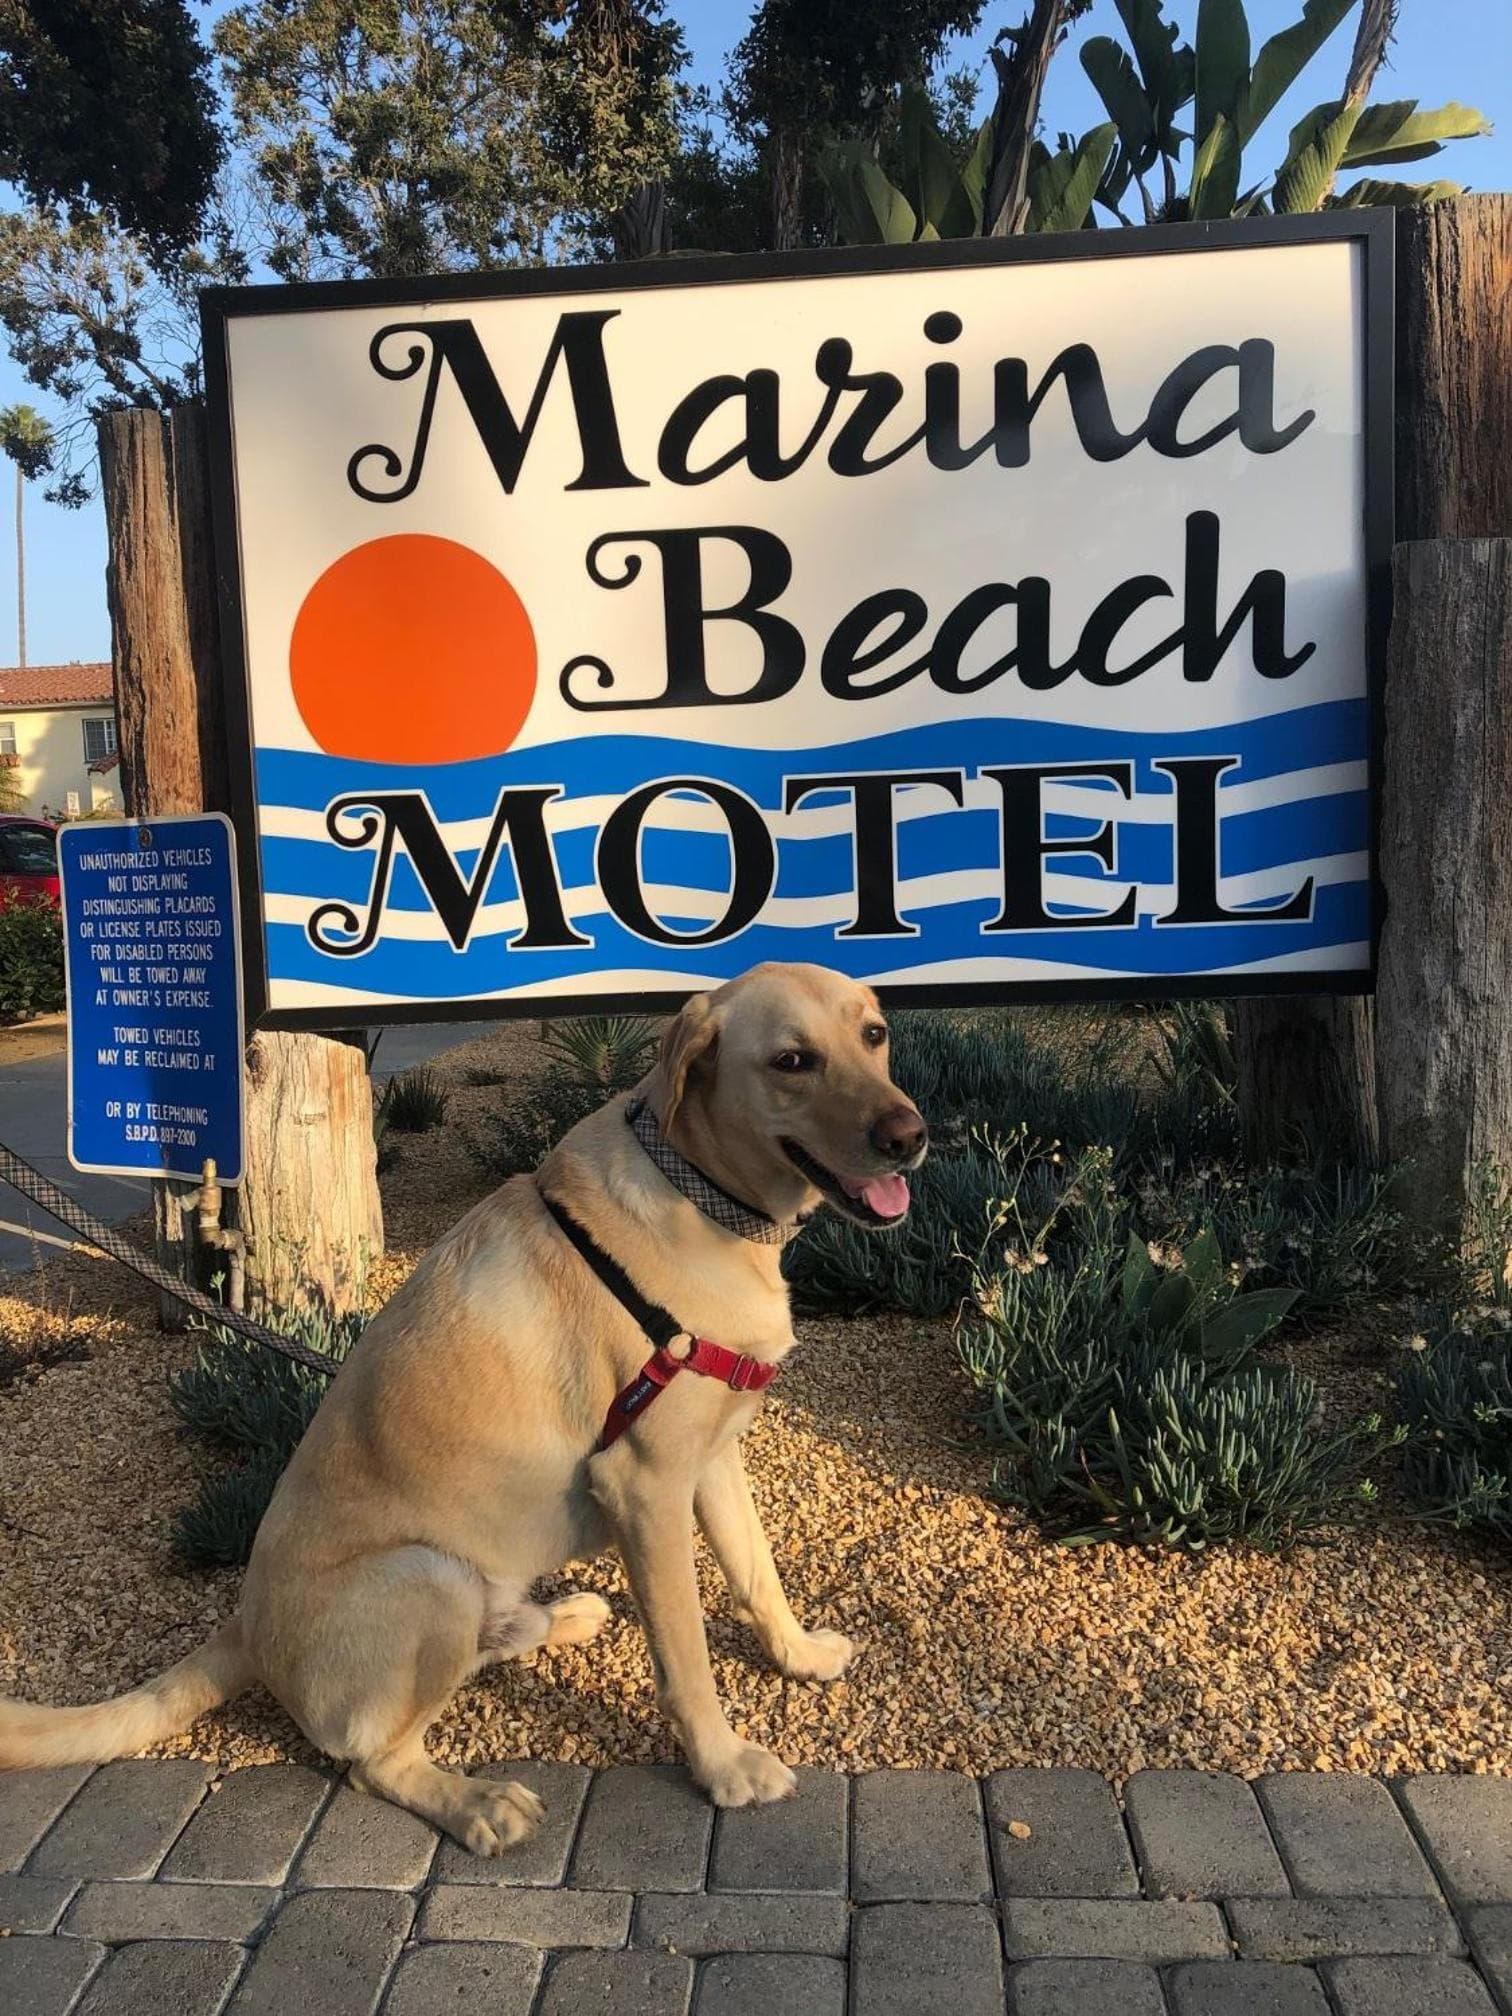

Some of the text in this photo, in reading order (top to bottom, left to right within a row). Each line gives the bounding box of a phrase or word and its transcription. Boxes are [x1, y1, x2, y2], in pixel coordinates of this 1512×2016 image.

[347, 308, 1316, 504] Marina
[559, 509, 1316, 713] Beach
[79, 848, 212, 870] UNAUTHORIZED VEHICLES
[306, 754, 1317, 956] MOTEL
[108, 874, 188, 892] NOT DISPLAYING
[83, 897, 216, 916] DISTINGUISHING PLACARDS
[80, 920, 222, 938] OR LICENSE PLATES ISSUED
[91, 944, 213, 961] FOR DISABLED PERSONS
[100, 967, 206, 984] WILL BE TOWED AWAY
[96, 989, 108, 1006] AT
[113, 990, 161, 1006] OWNER'S
[113, 1027, 200, 1046] TOWED VEHICLES
[98, 1049, 215, 1071] MAY BE RECLAIMED AT
[106, 1101, 208, 1125] OR BY TELEPHONING
